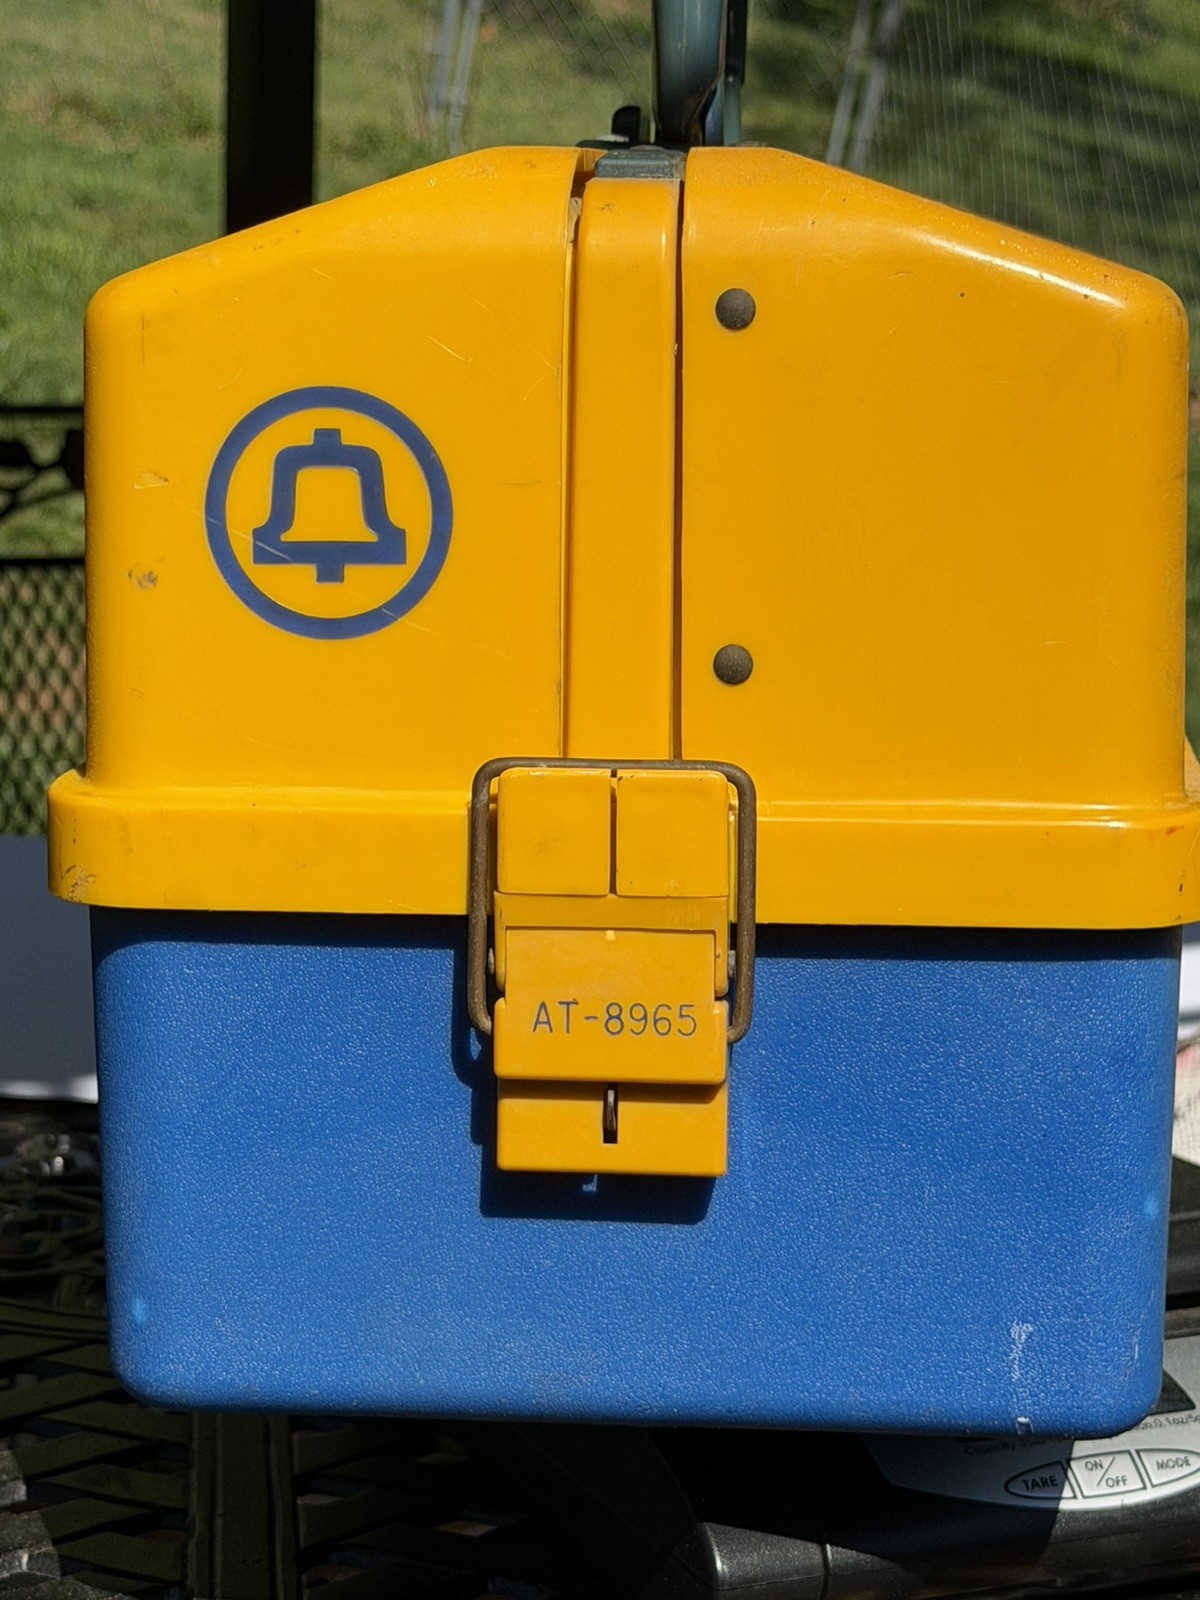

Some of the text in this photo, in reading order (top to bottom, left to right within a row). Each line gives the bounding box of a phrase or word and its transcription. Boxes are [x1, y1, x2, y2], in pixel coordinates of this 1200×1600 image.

[532, 1000, 697, 1037] AT-8965
[1085, 1459, 1103, 1472] ON
[1156, 1456, 1191, 1471] MODE
[1022, 1475, 1058, 1492] TARE
[1105, 1474, 1129, 1488] OFF
